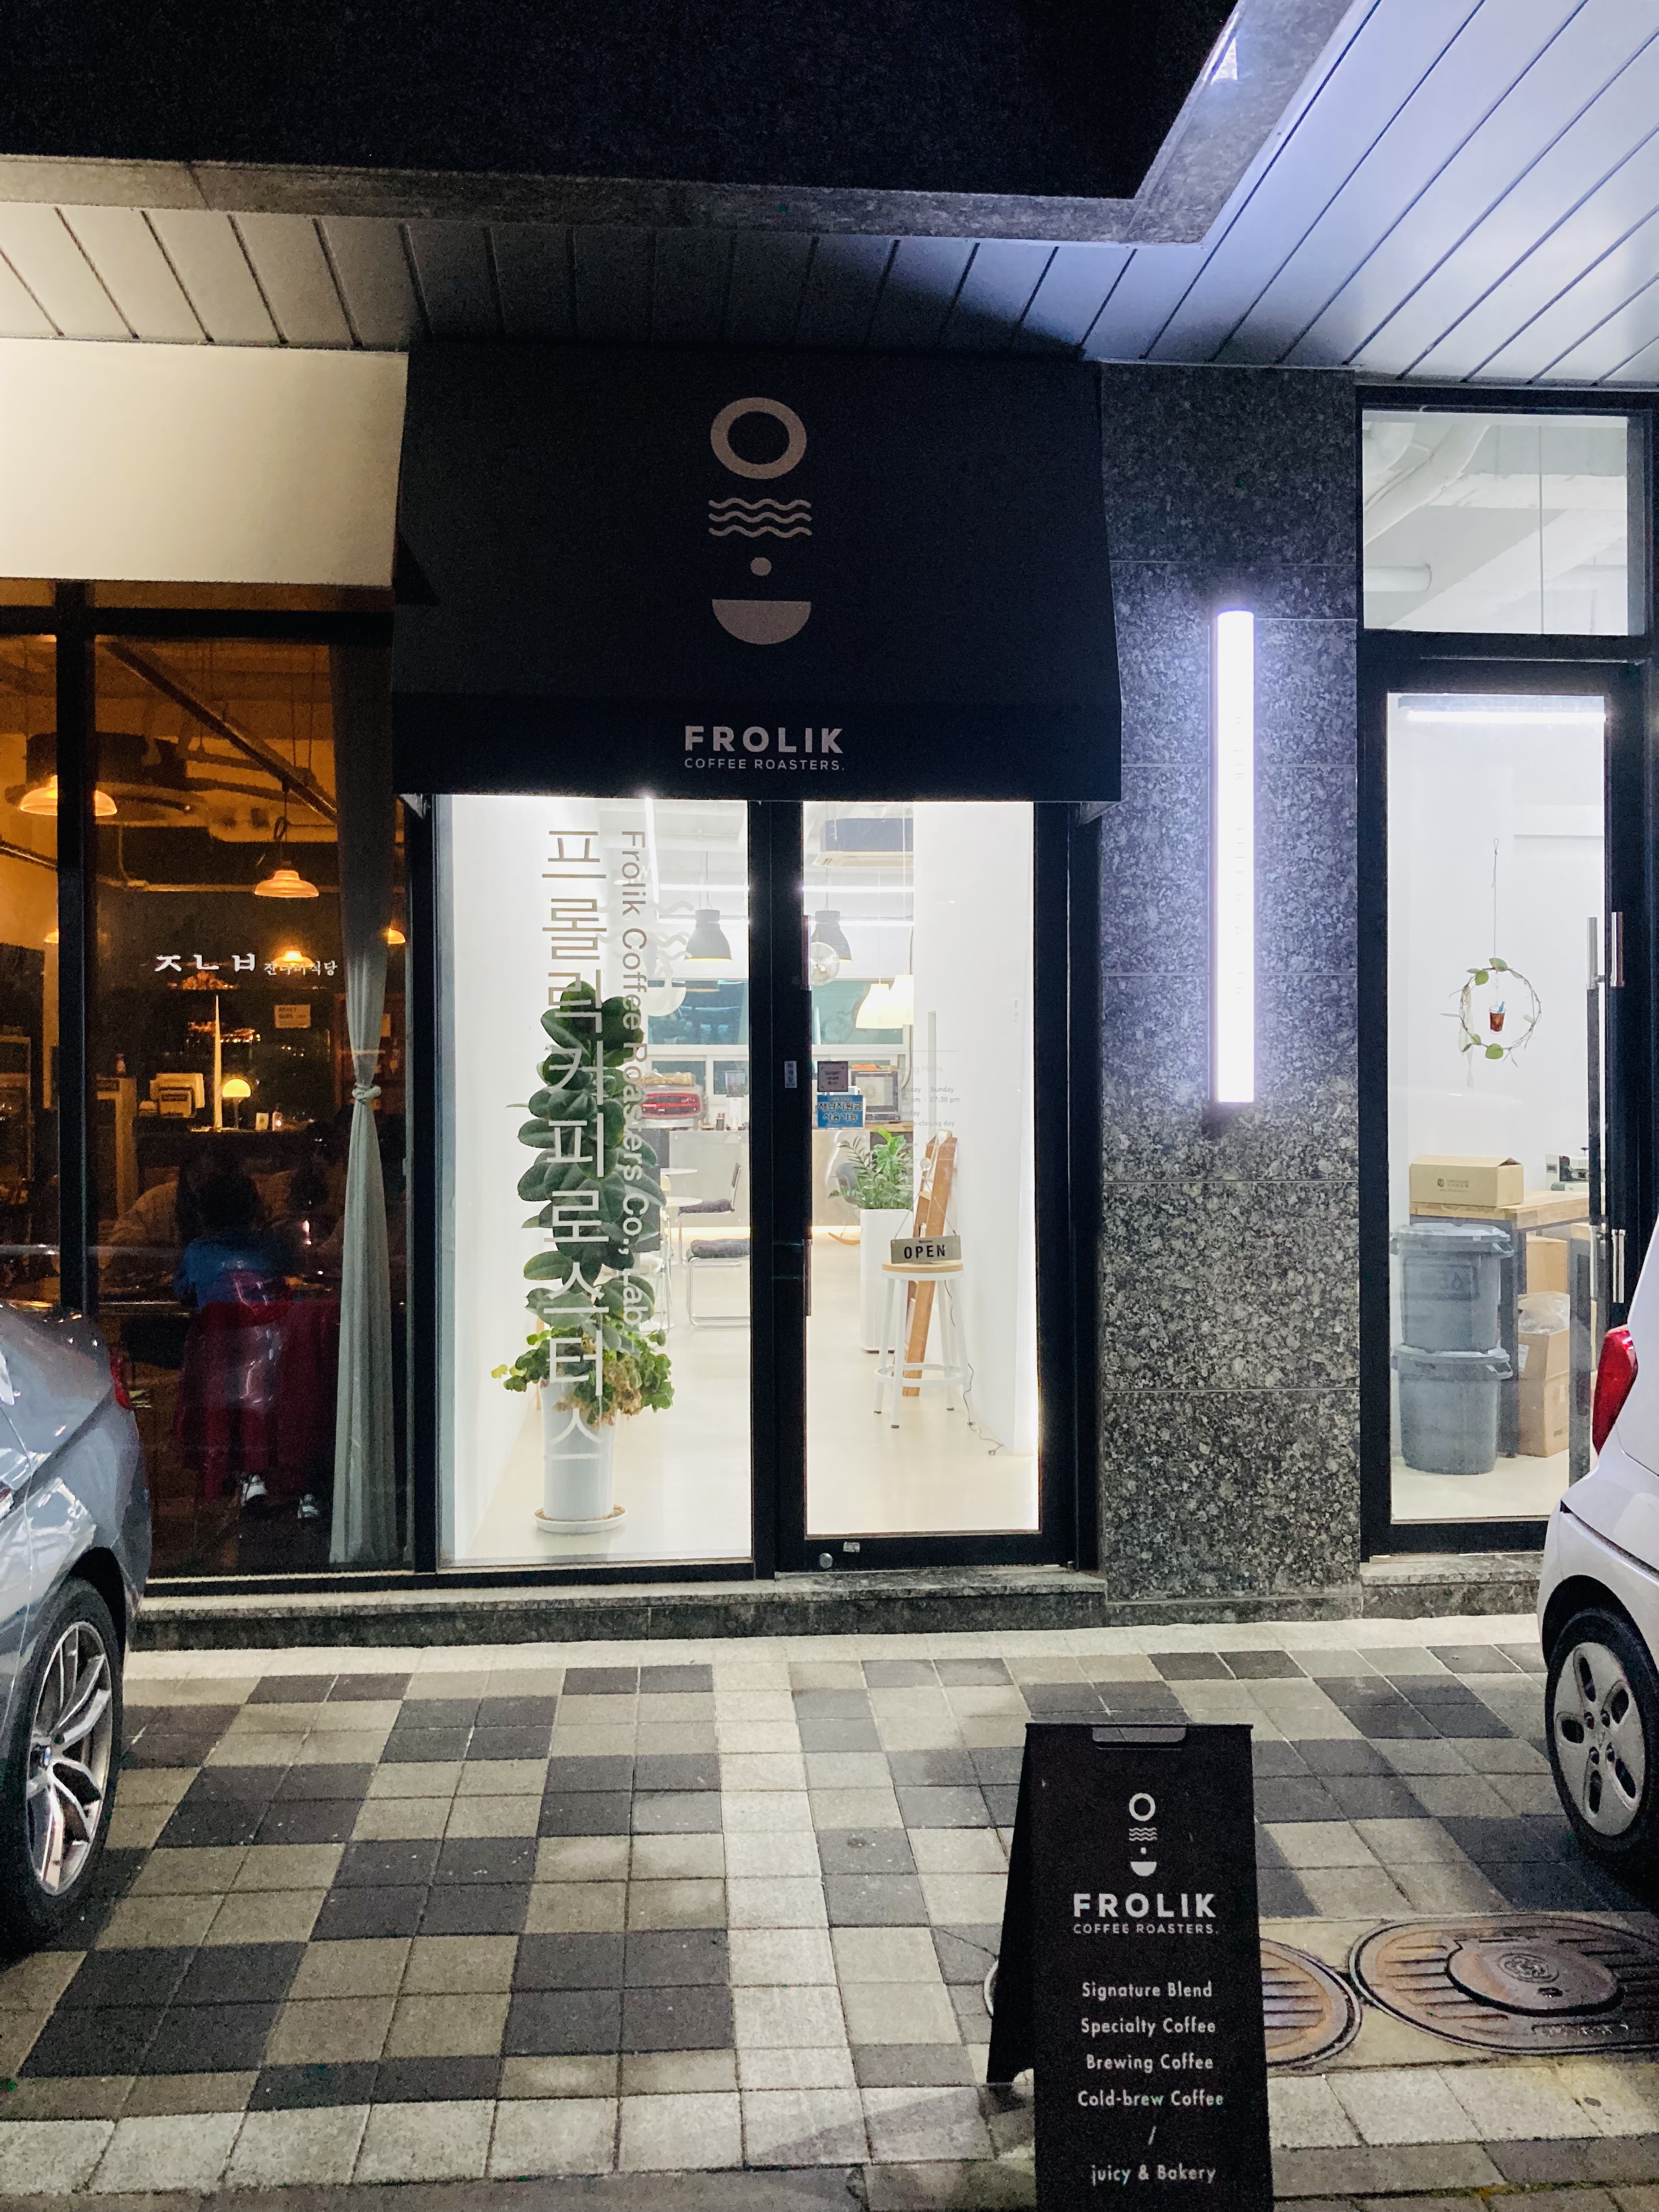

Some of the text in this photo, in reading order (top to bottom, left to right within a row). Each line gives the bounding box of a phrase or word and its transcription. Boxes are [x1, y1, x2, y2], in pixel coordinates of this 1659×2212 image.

[685, 725, 843, 753] FROLIK
[685, 758, 747, 769] COFFEE
[622, 831, 647, 915] Frolik
[622, 928, 648, 1030] Coffee
[622, 1043, 648, 1182] Roasters
[904, 1244, 945, 1259] OPEN
[622, 1271, 648, 1325] Lab
[1073, 1893, 1216, 1918] FROLIK
[1073, 1923, 1129, 1934] COFFEE
[1082, 1980, 1212, 2001] Signature Blend
[1081, 2016, 1216, 2038] Specialty Coffee
[1086, 2052, 1214, 2073] Brewing Coffee
[1077, 2088, 1224, 2107] Cold-brew Coffee
[1091, 2162, 1216, 2187] juicy & Bakery
